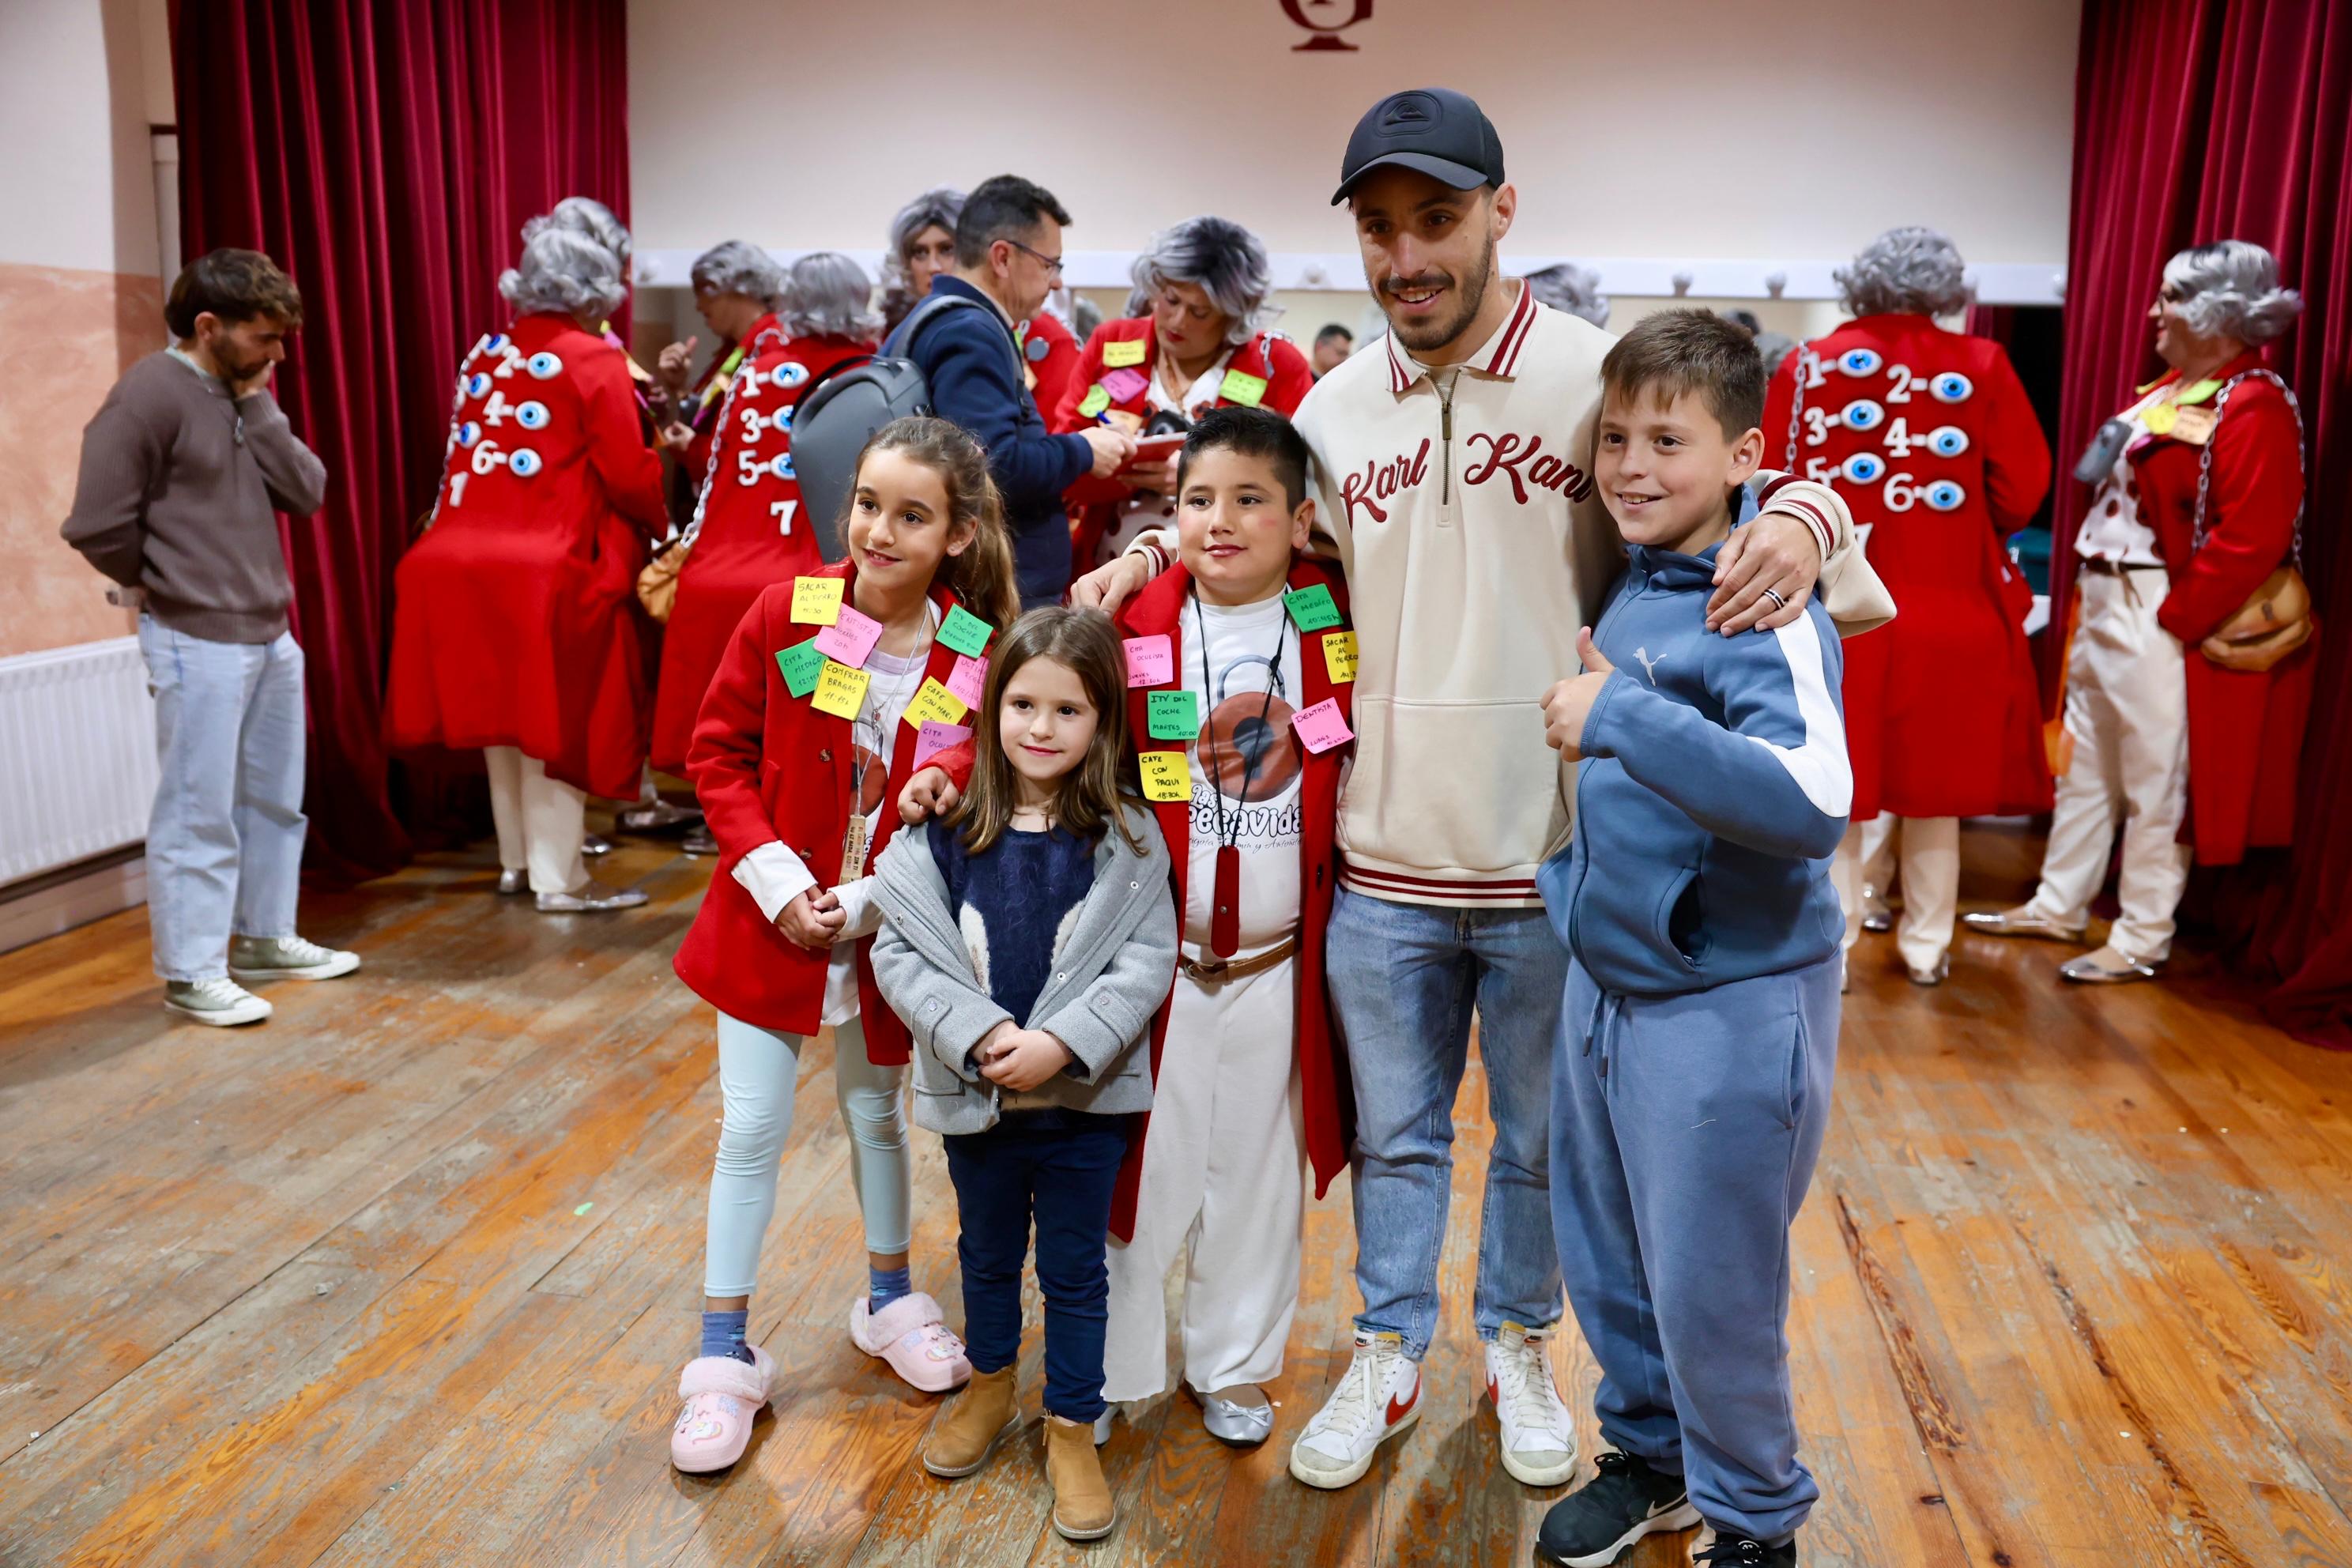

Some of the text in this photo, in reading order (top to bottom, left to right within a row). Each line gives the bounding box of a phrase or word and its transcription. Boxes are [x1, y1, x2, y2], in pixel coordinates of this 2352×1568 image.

[741, 366, 761, 397] 1
[1886, 364, 1912, 403] 2
[483, 390, 506, 426] 4
[741, 408, 761, 443] 3
[1804, 407, 1827, 446] 3
[1883, 418, 1911, 457] 4
[471, 439, 499, 475] 6
[738, 450, 760, 486] 5
[1340, 438, 1431, 530] Karl
[1883, 473, 1914, 512] 6
[770, 500, 798, 535] 7
[1288, 594, 1309, 605] CITA
[1326, 636, 1349, 647] SACAR
[784, 654, 802, 666] CITA
[794, 656, 822, 674] MEDICO
[1335, 654, 1359, 664] PERRO
[826, 664, 865, 682] COMPRAR
[827, 677, 856, 694] BRAGAS
[922, 695, 937, 707] CON
[1151, 694, 1170, 703] ITV
[1295, 703, 1332, 723] DENTISTA
[923, 728, 942, 737] CITA
[1152, 766, 1168, 775] CON
